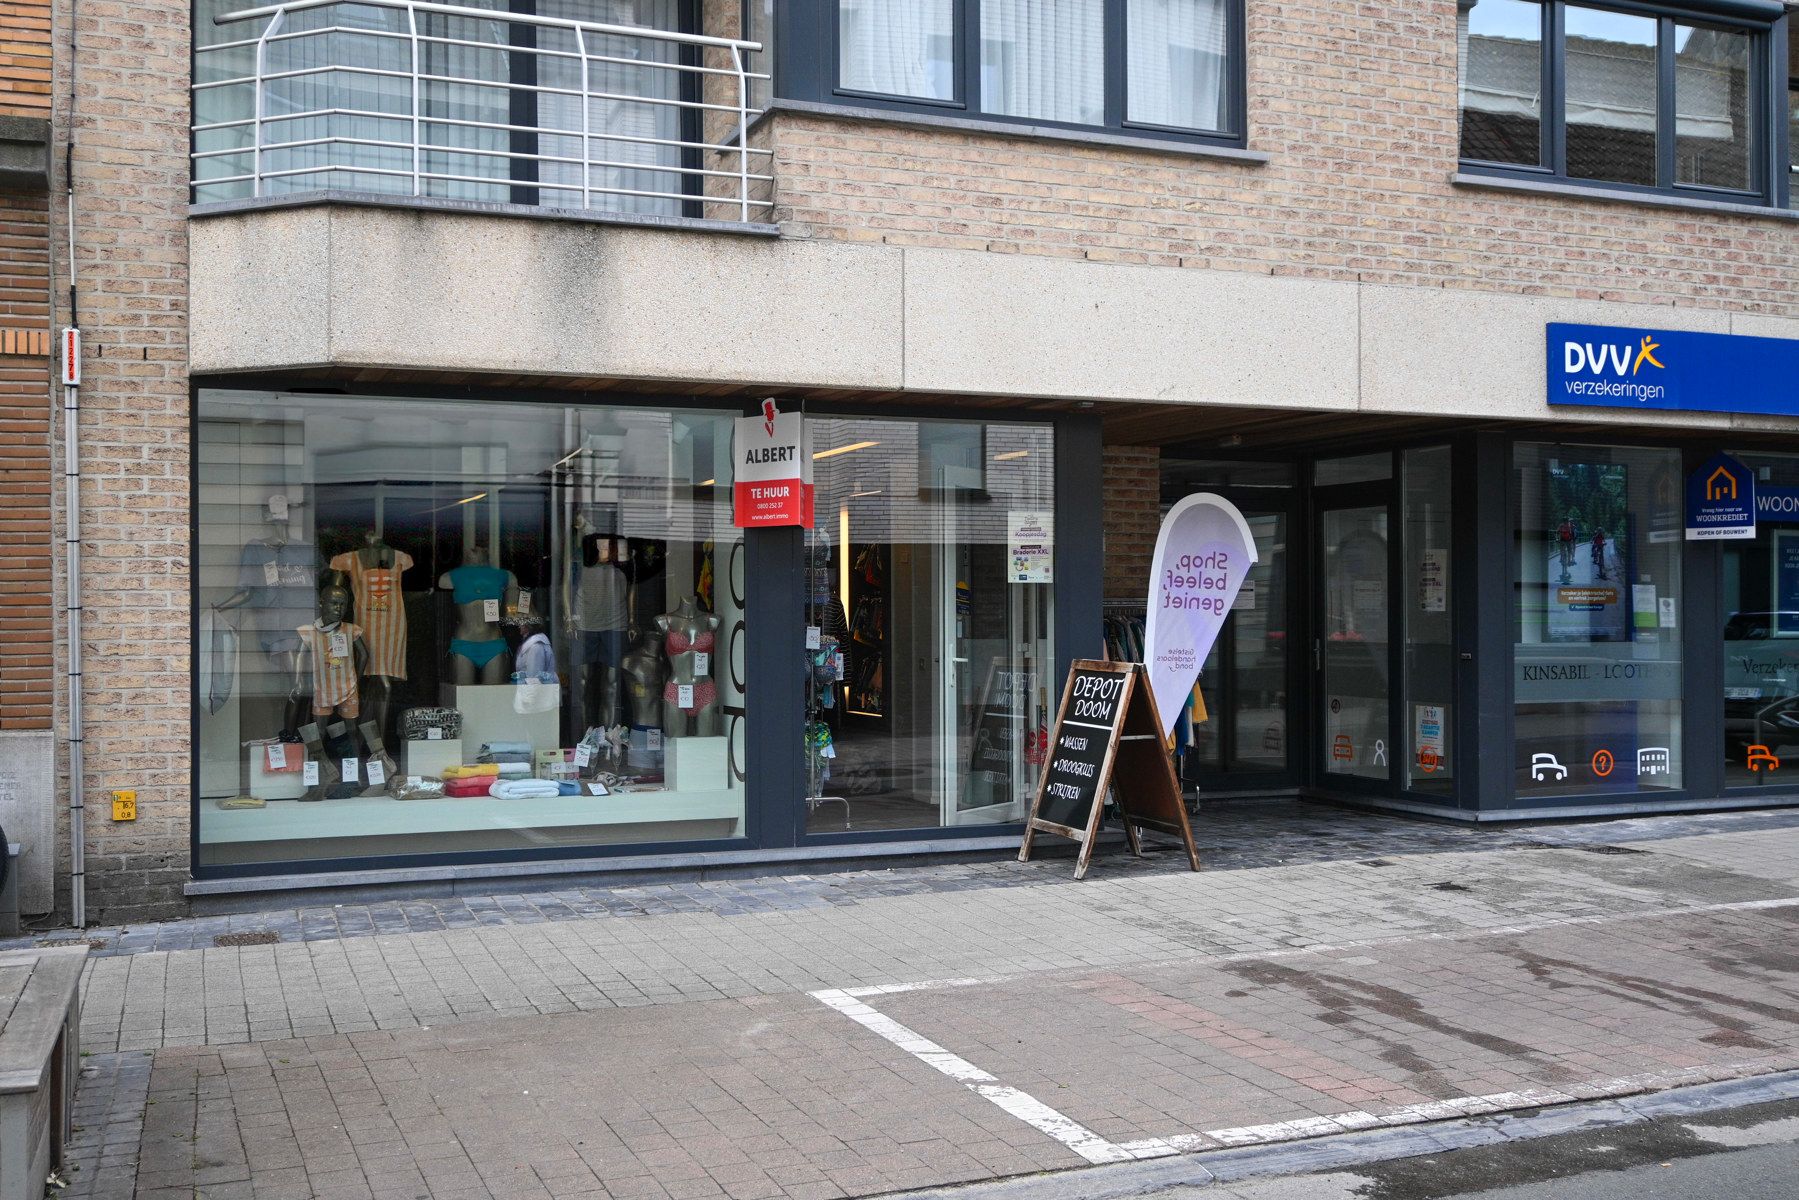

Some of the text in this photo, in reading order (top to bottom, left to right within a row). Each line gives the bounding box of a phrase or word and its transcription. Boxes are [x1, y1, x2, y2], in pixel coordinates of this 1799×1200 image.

[1564, 341, 1632, 376] DVV
[1565, 379, 1665, 402] verzekeringen
[745, 445, 796, 465] ALBERT
[750, 486, 790, 500] TE HUUR
[1696, 513, 1749, 522] WOONKREDIET
[1073, 675, 1125, 700] DEPOT
[1074, 699, 1112, 720] DOOM
